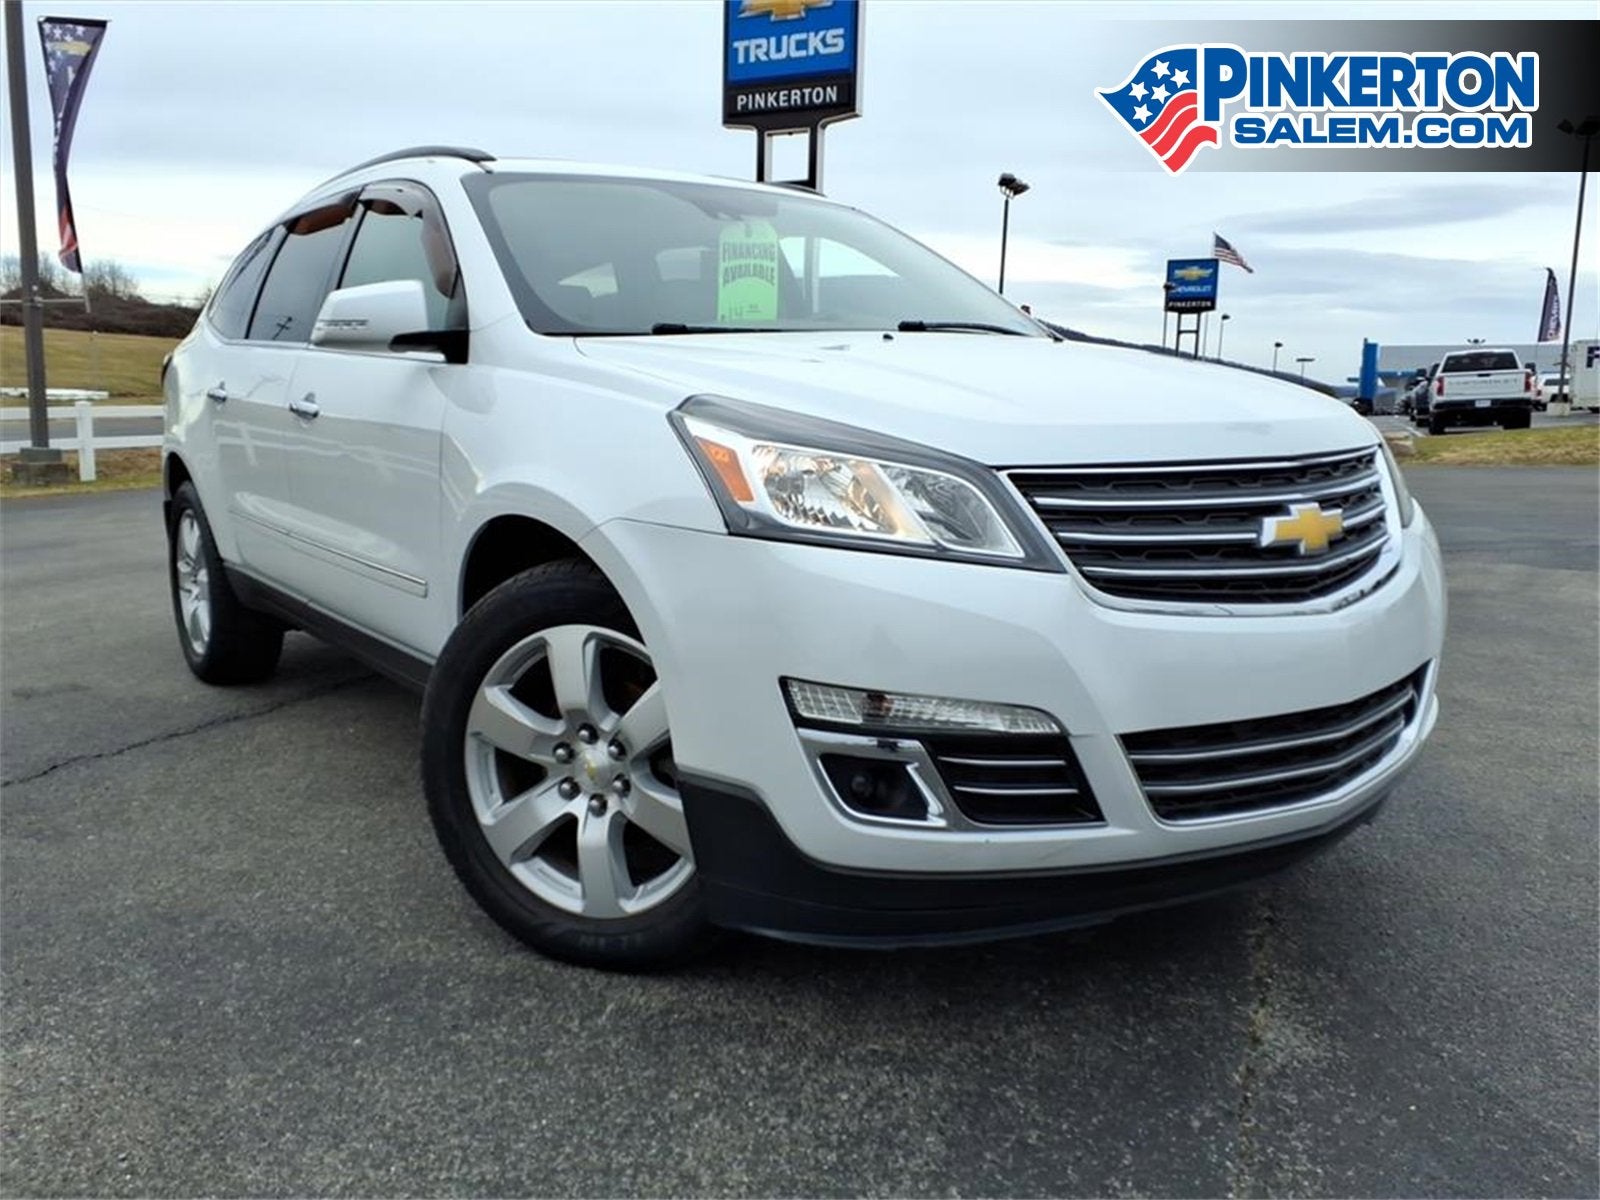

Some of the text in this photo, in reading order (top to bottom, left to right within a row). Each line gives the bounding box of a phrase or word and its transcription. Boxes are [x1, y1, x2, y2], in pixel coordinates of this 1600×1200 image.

[733, 28, 845, 64] TRUCKS
[737, 85, 838, 110] PINKERTON
[722, 241, 776, 263] FINANCING
[723, 263, 776, 287] AVAILABLE
